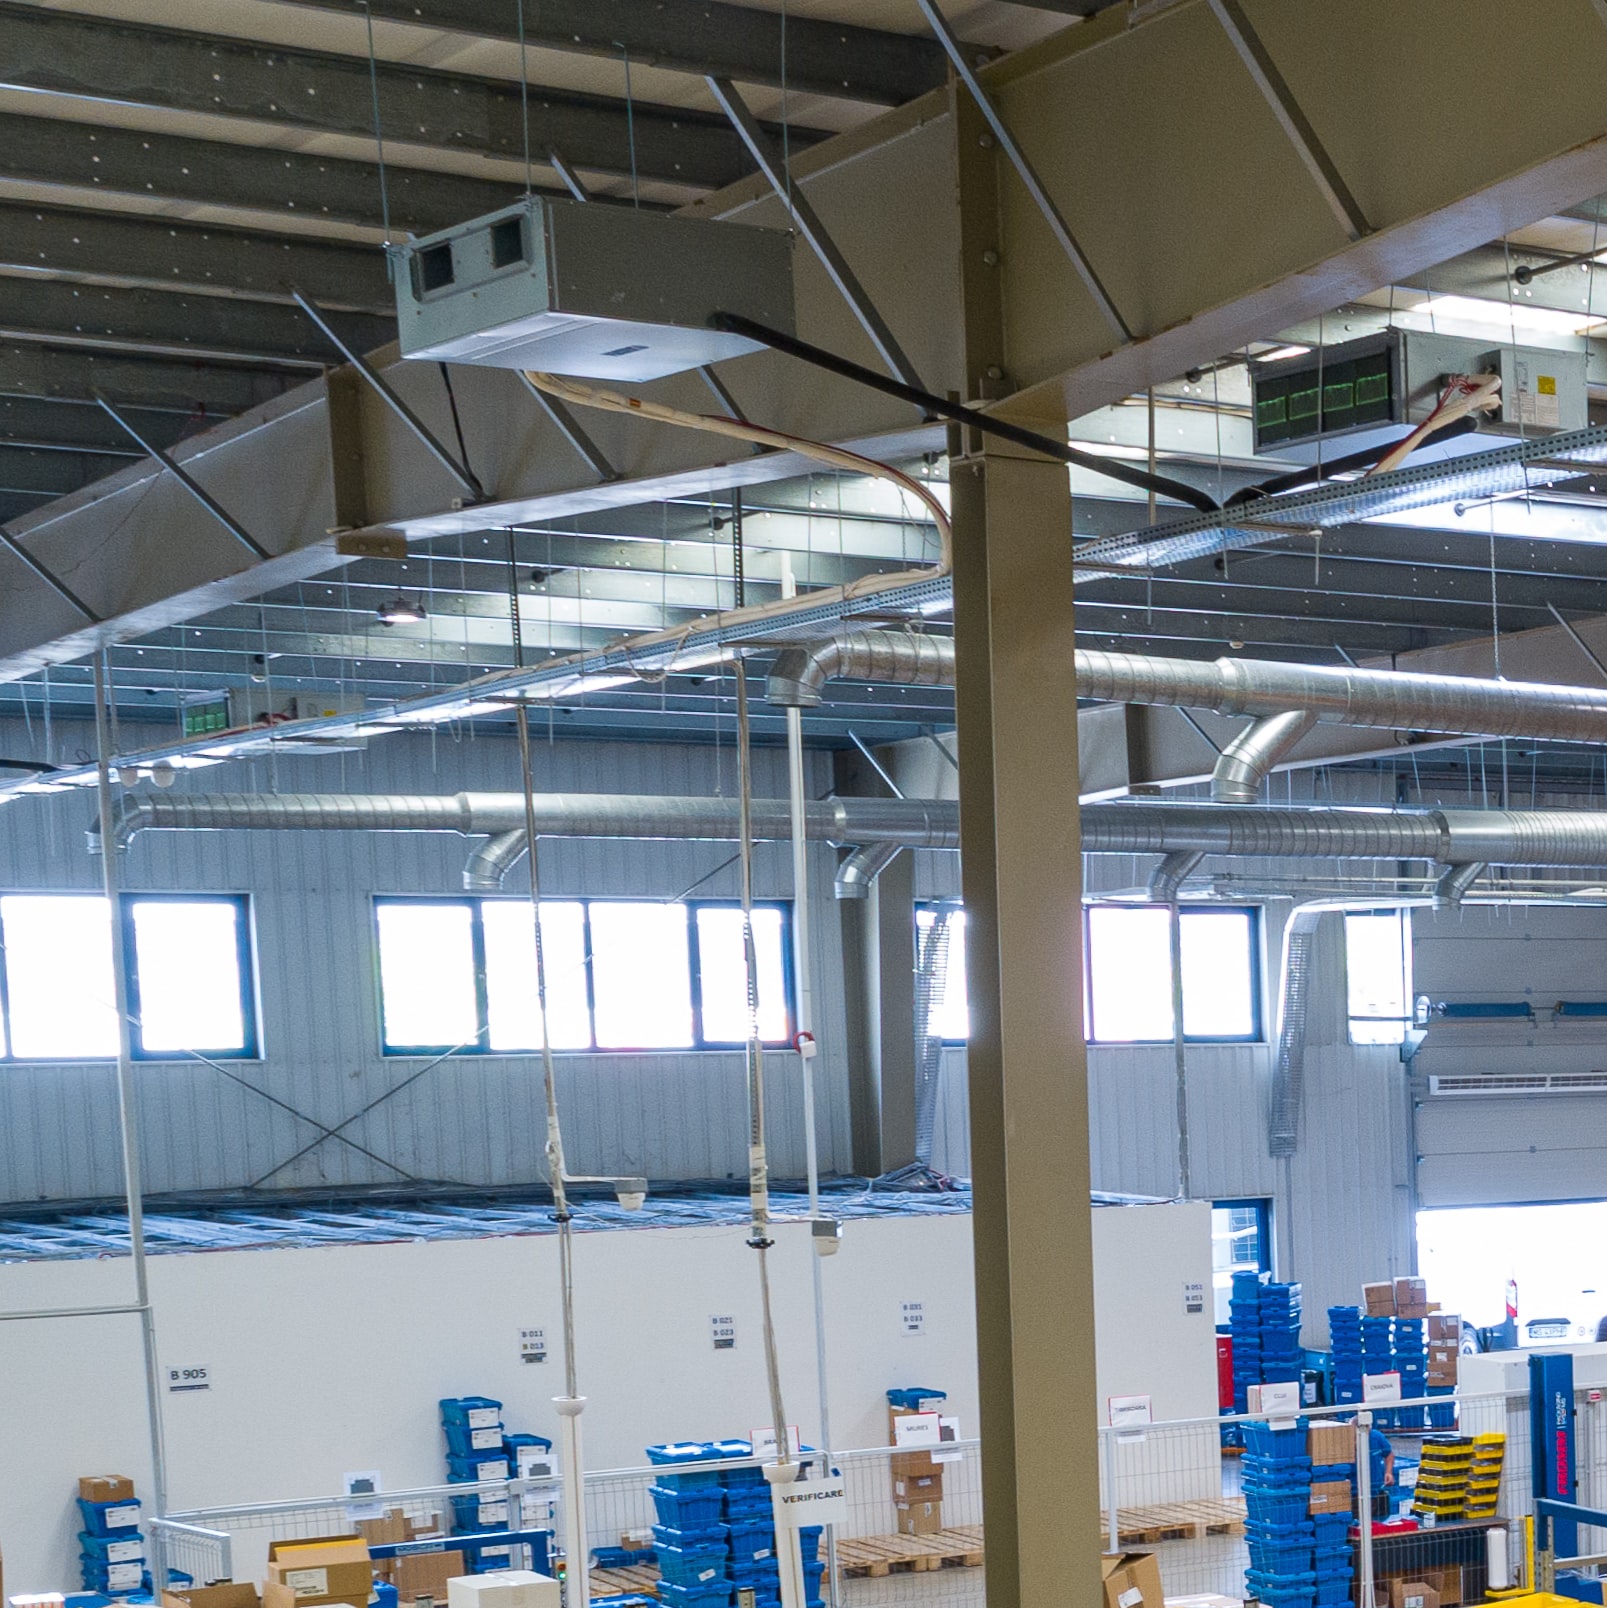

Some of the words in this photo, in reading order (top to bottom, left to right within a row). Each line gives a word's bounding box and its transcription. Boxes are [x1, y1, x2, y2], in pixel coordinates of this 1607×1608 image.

[171, 1370, 180, 1380] B
[183, 1369, 207, 1379] 905
[1557, 1431, 1568, 1494] FROMM
[782, 1489, 844, 1505] VERIFICARE
